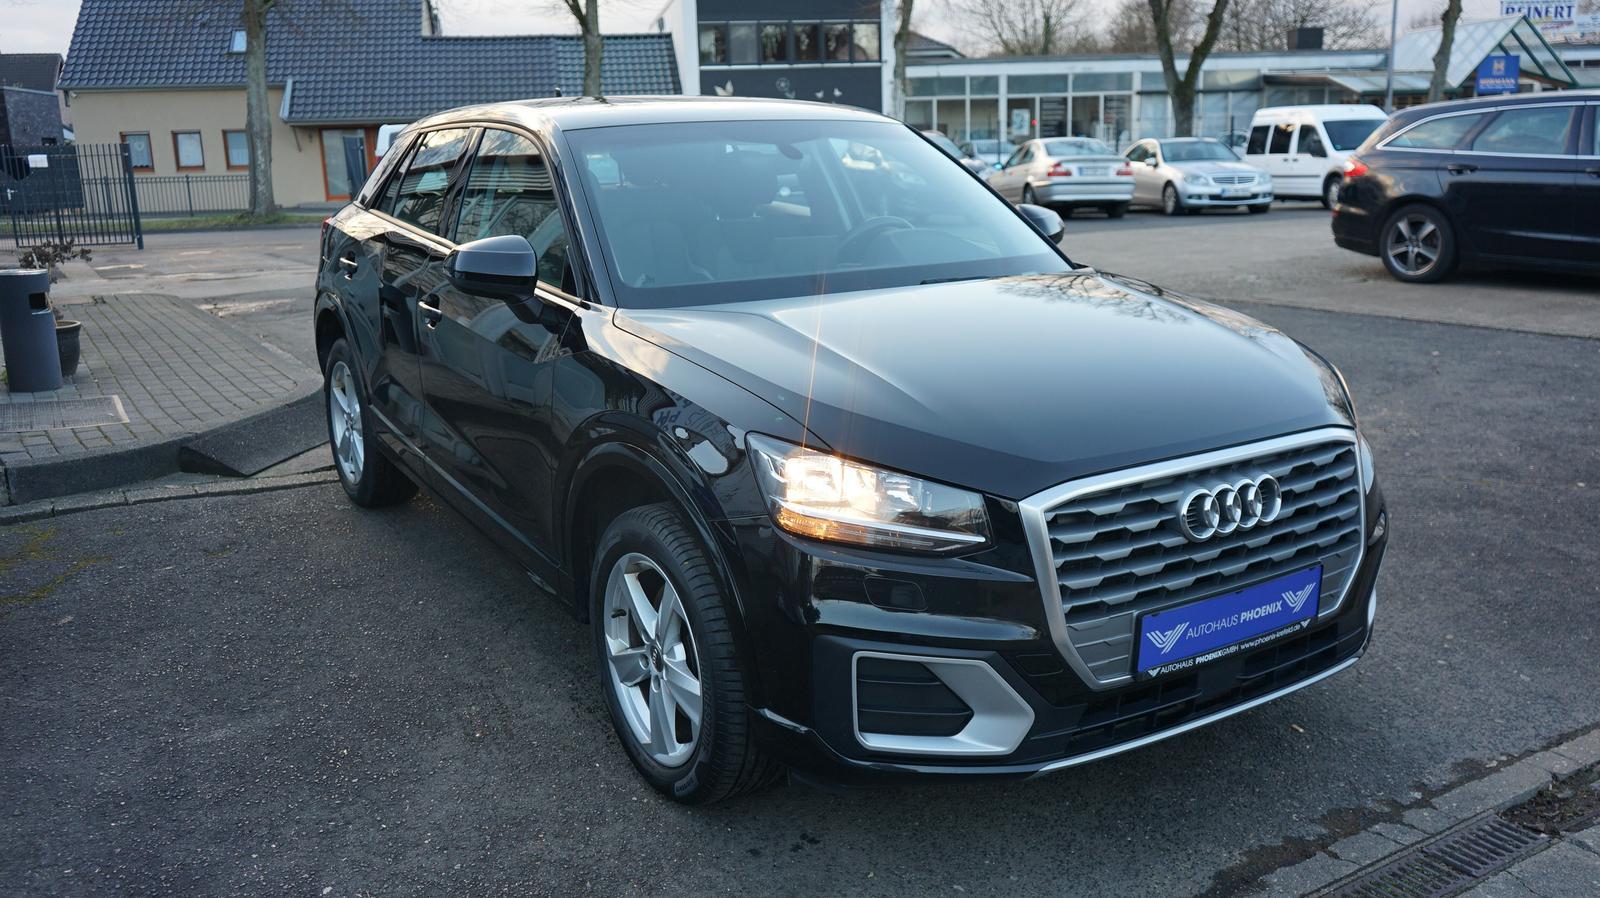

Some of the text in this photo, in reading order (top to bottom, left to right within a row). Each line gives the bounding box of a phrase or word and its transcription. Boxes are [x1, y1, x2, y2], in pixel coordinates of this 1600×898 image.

[1186, 600, 1283, 640] AUTOHAUS PHOENIX
[1160, 659, 1194, 675] AUTOHAUS
